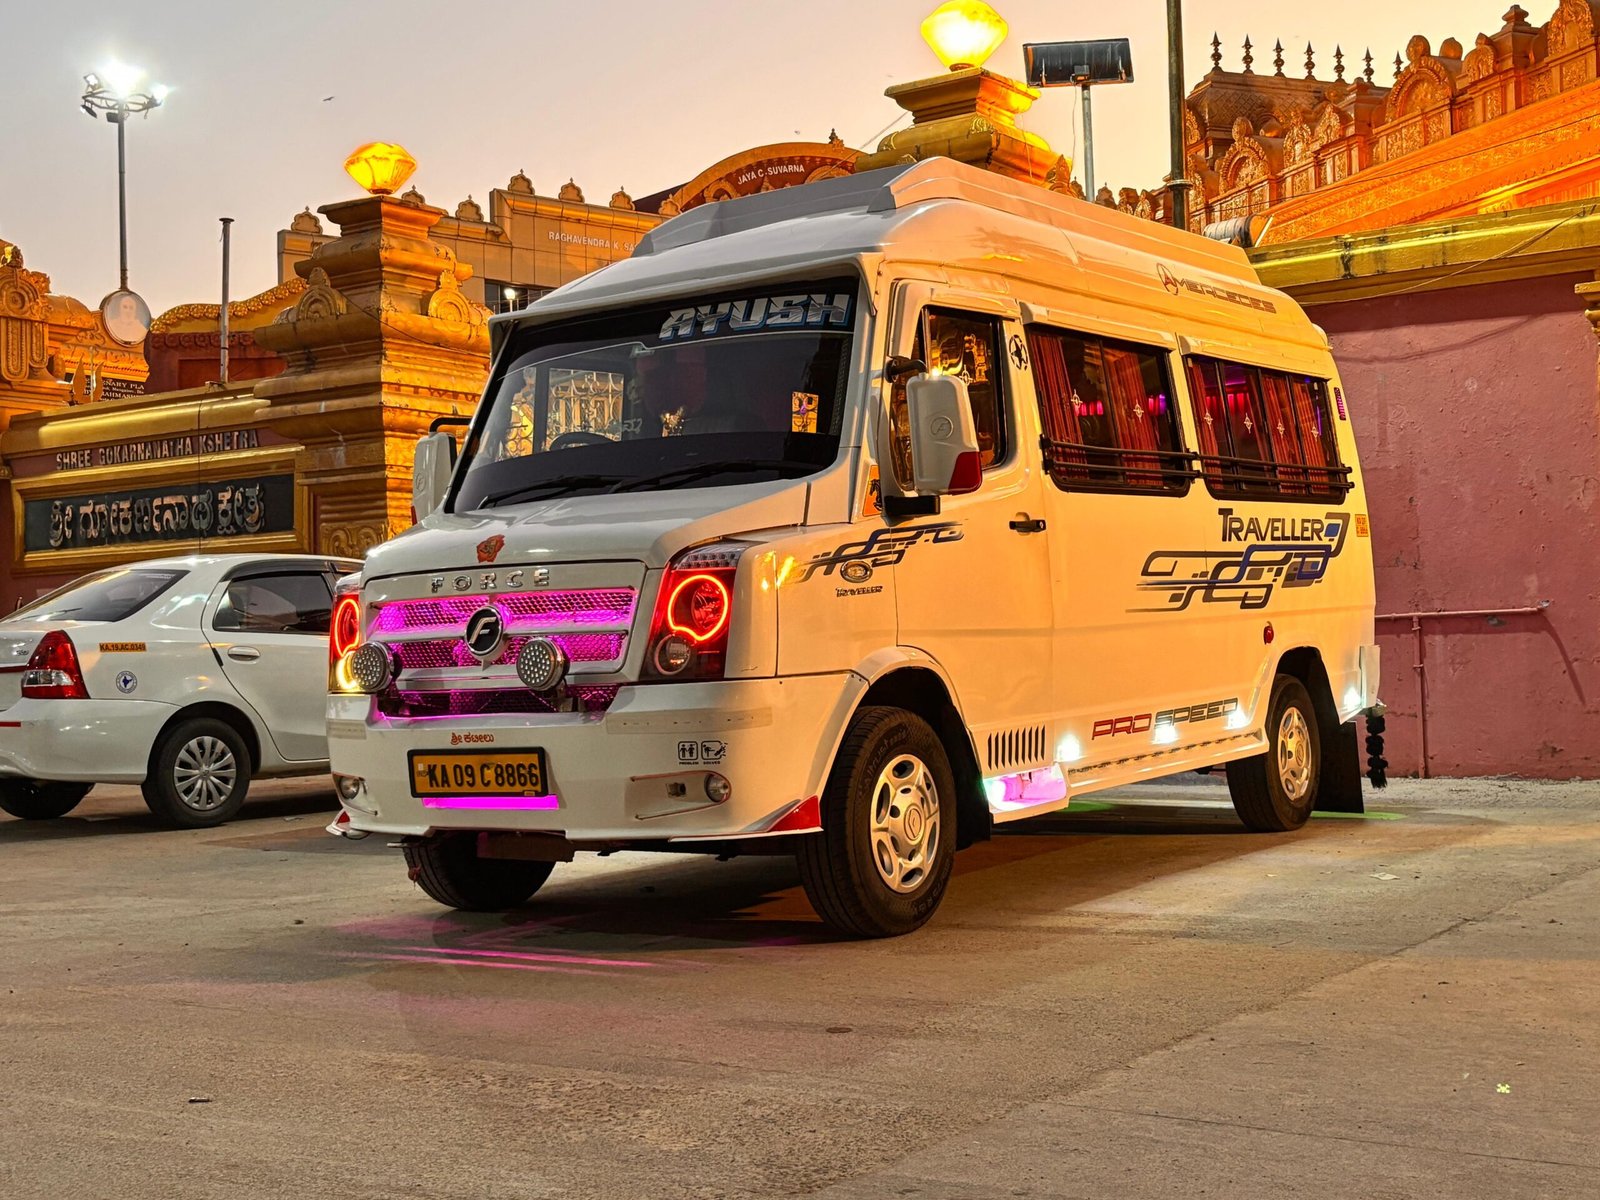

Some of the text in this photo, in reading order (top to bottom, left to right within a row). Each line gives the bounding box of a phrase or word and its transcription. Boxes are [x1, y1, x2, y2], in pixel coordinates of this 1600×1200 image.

[738, 171, 757, 185] JAYA
[767, 164, 805, 176] SUVARNA
[548, 231, 610, 249] RAGHAVENDRA
[659, 294, 850, 341] AYUSH
[56, 429, 259, 470] SHREE GOKARNANATHA KSHETRA
[50, 500, 74, 547] ಶ್ರೀ
[217, 483, 266, 535] ಕ್ಷೇತ್ರ
[1218, 508, 1324, 542] TRAVELLER
[431, 569, 549, 593] FORCE
[1092, 698, 1239, 741] PRO SPEED
[450, 732, 462, 746] ಶ್ರೀ
[427, 763, 540, 788] KA 09 C 8866
